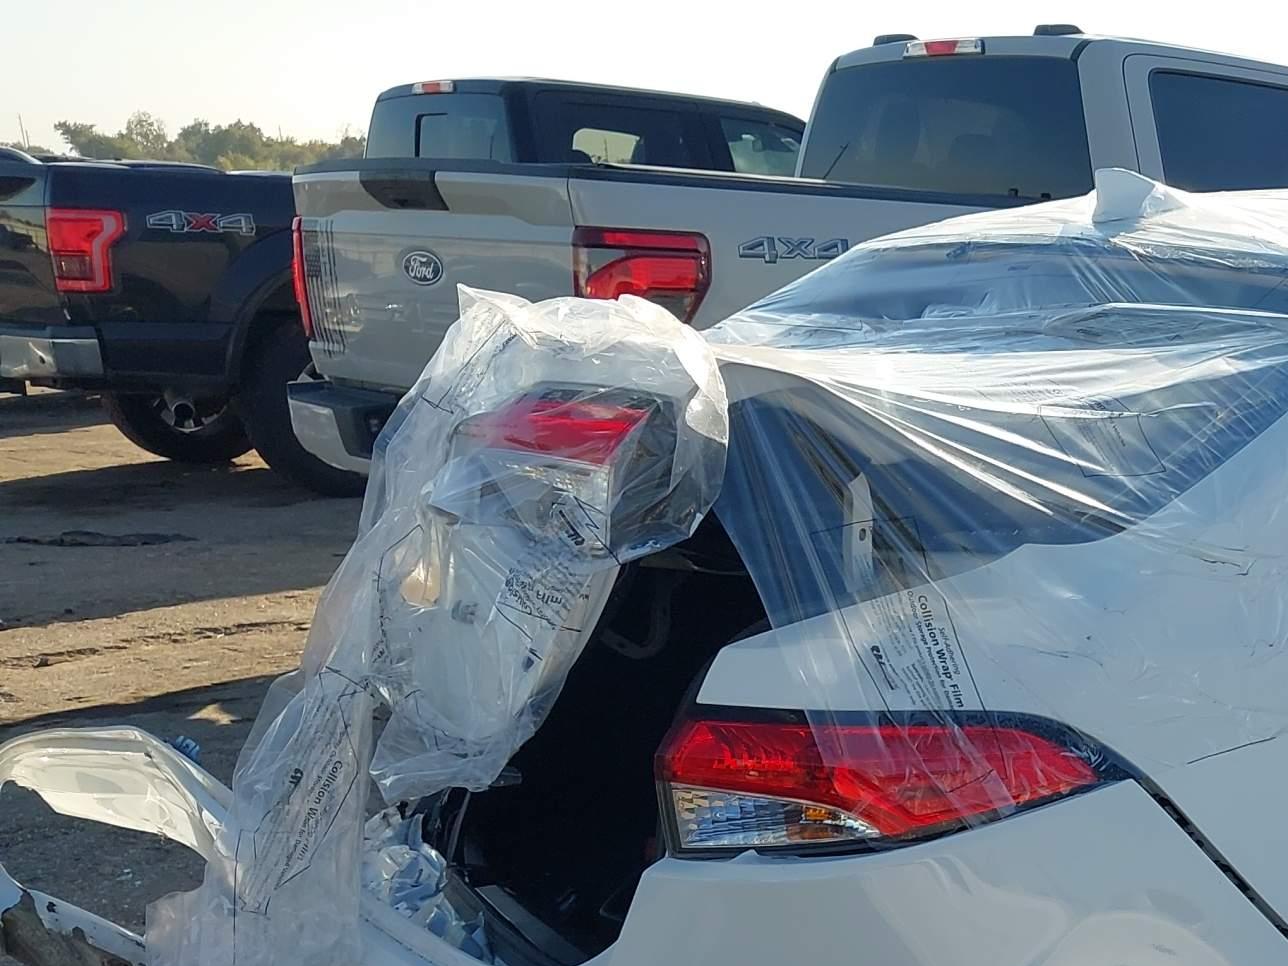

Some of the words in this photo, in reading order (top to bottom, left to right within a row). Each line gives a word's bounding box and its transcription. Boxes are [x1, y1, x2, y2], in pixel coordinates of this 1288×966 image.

[406, 253, 437, 281] Ford
[918, 594, 940, 647] Collision
[950, 683, 964, 708] Film
[316, 760, 343, 804] Collision
